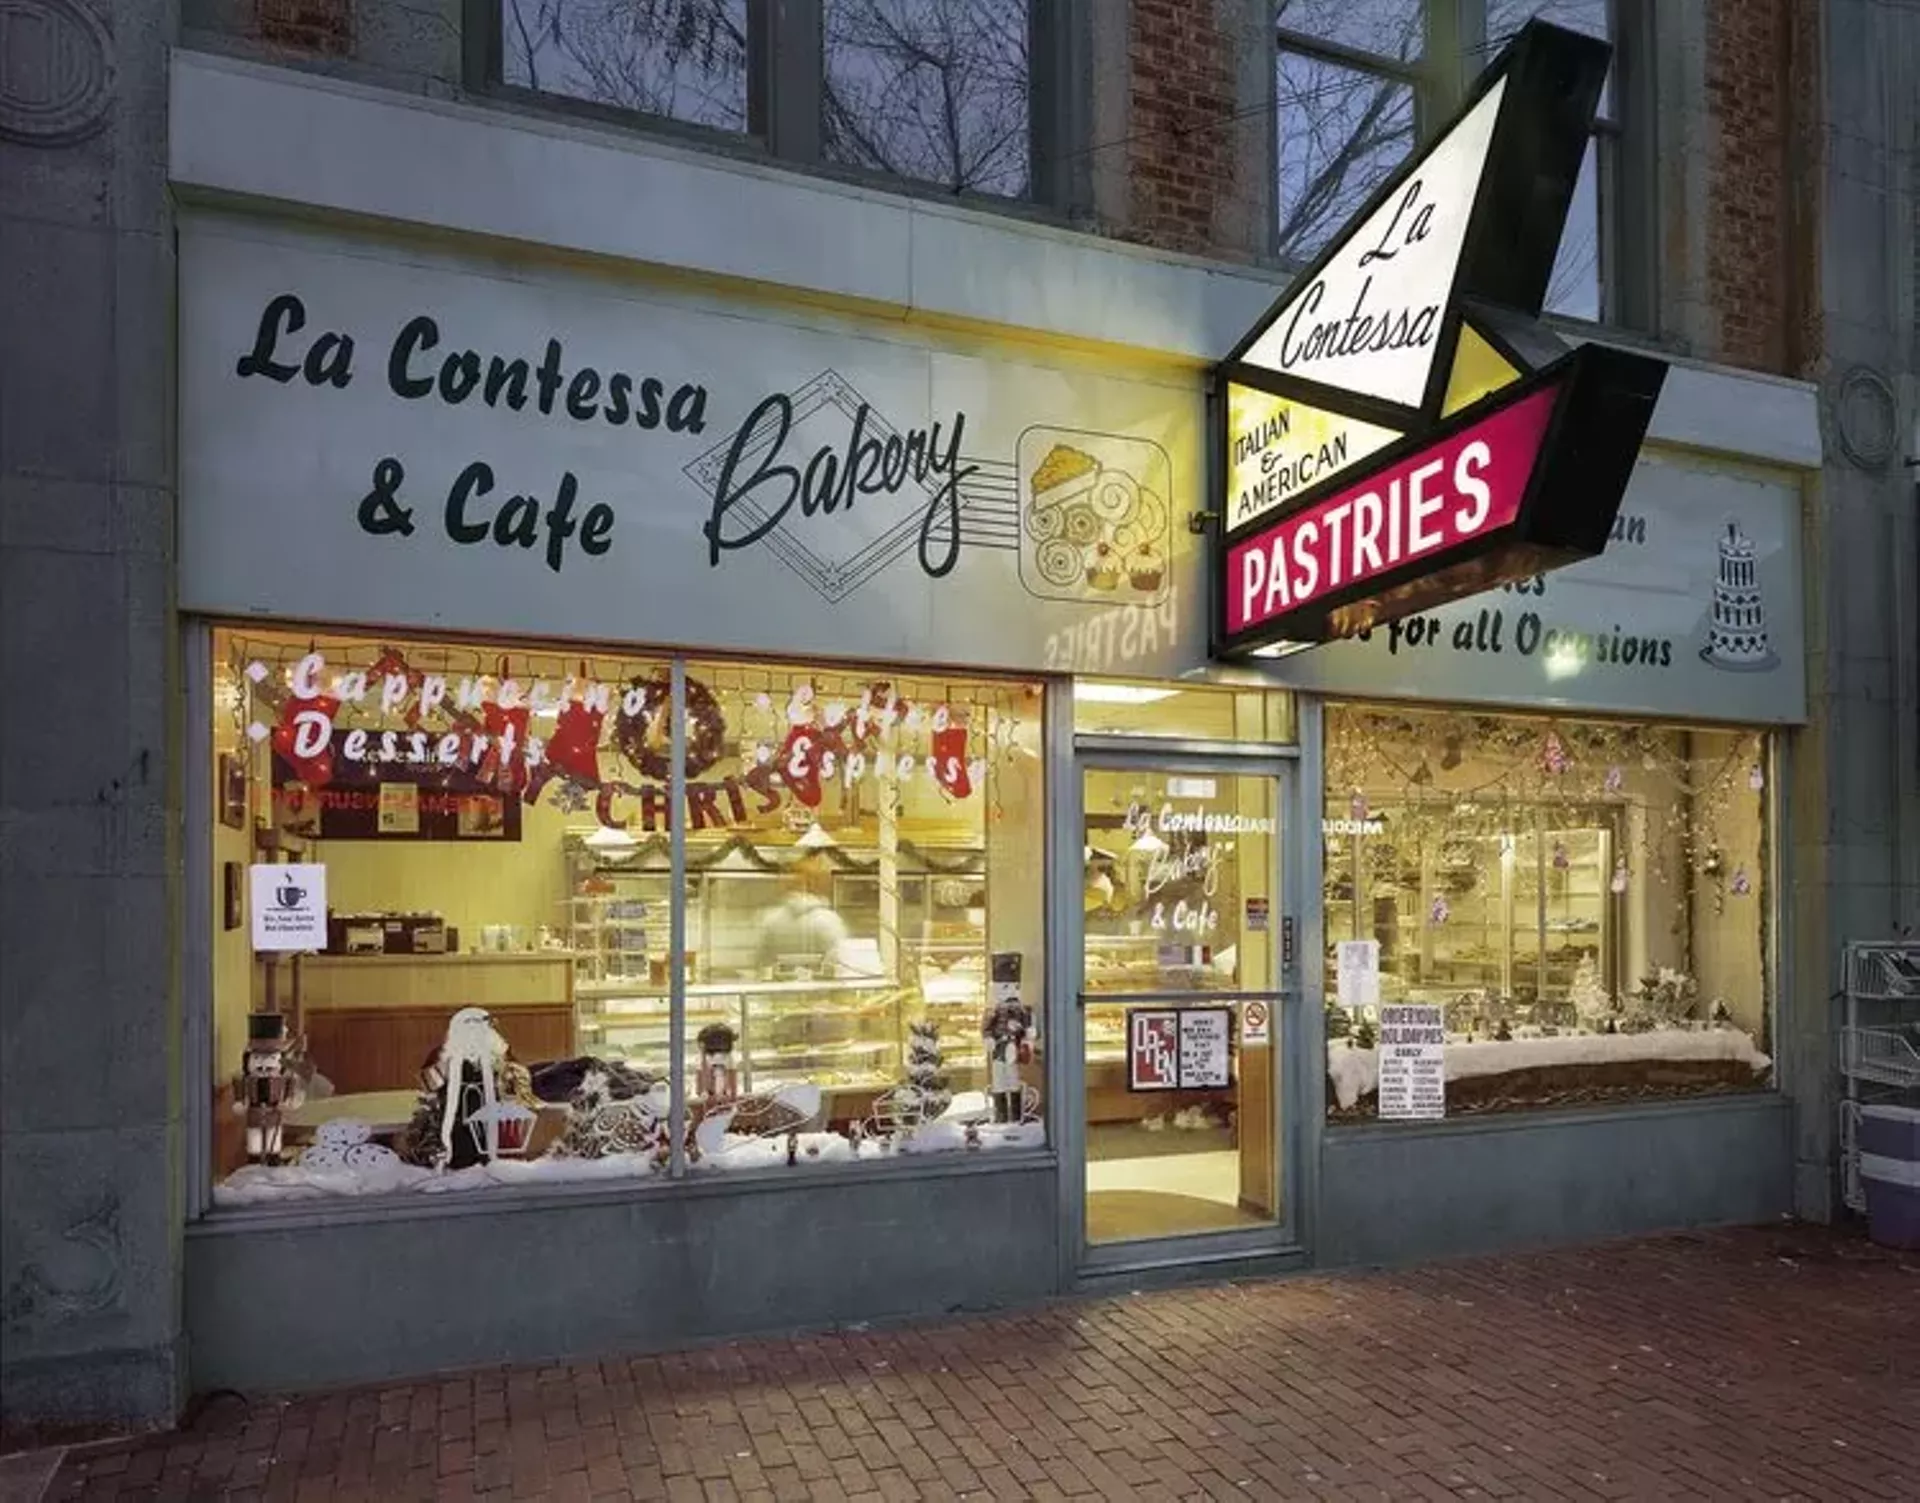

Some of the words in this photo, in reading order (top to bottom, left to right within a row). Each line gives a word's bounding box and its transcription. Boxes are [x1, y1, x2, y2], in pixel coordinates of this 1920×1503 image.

[1357, 179, 1437, 268] La
[236, 294, 354, 389] La
[387, 316, 708, 434] Contessa
[1280, 275, 1442, 368] Contessa
[1233, 409, 1291, 464] ITALIAN
[1236, 431, 1348, 518] AMERICAN
[1259, 451, 1283, 475] &
[356, 457, 415, 537] &
[444, 461, 614, 572] Cafe
[702, 393, 979, 578] Bakery
[1242, 440, 1492, 622] PASTRIES
[1387, 615, 1440, 655] for
[1452, 608, 1503, 653] all
[292, 709, 543, 767] Desserts
[1173, 901, 1218, 931] Cafe
